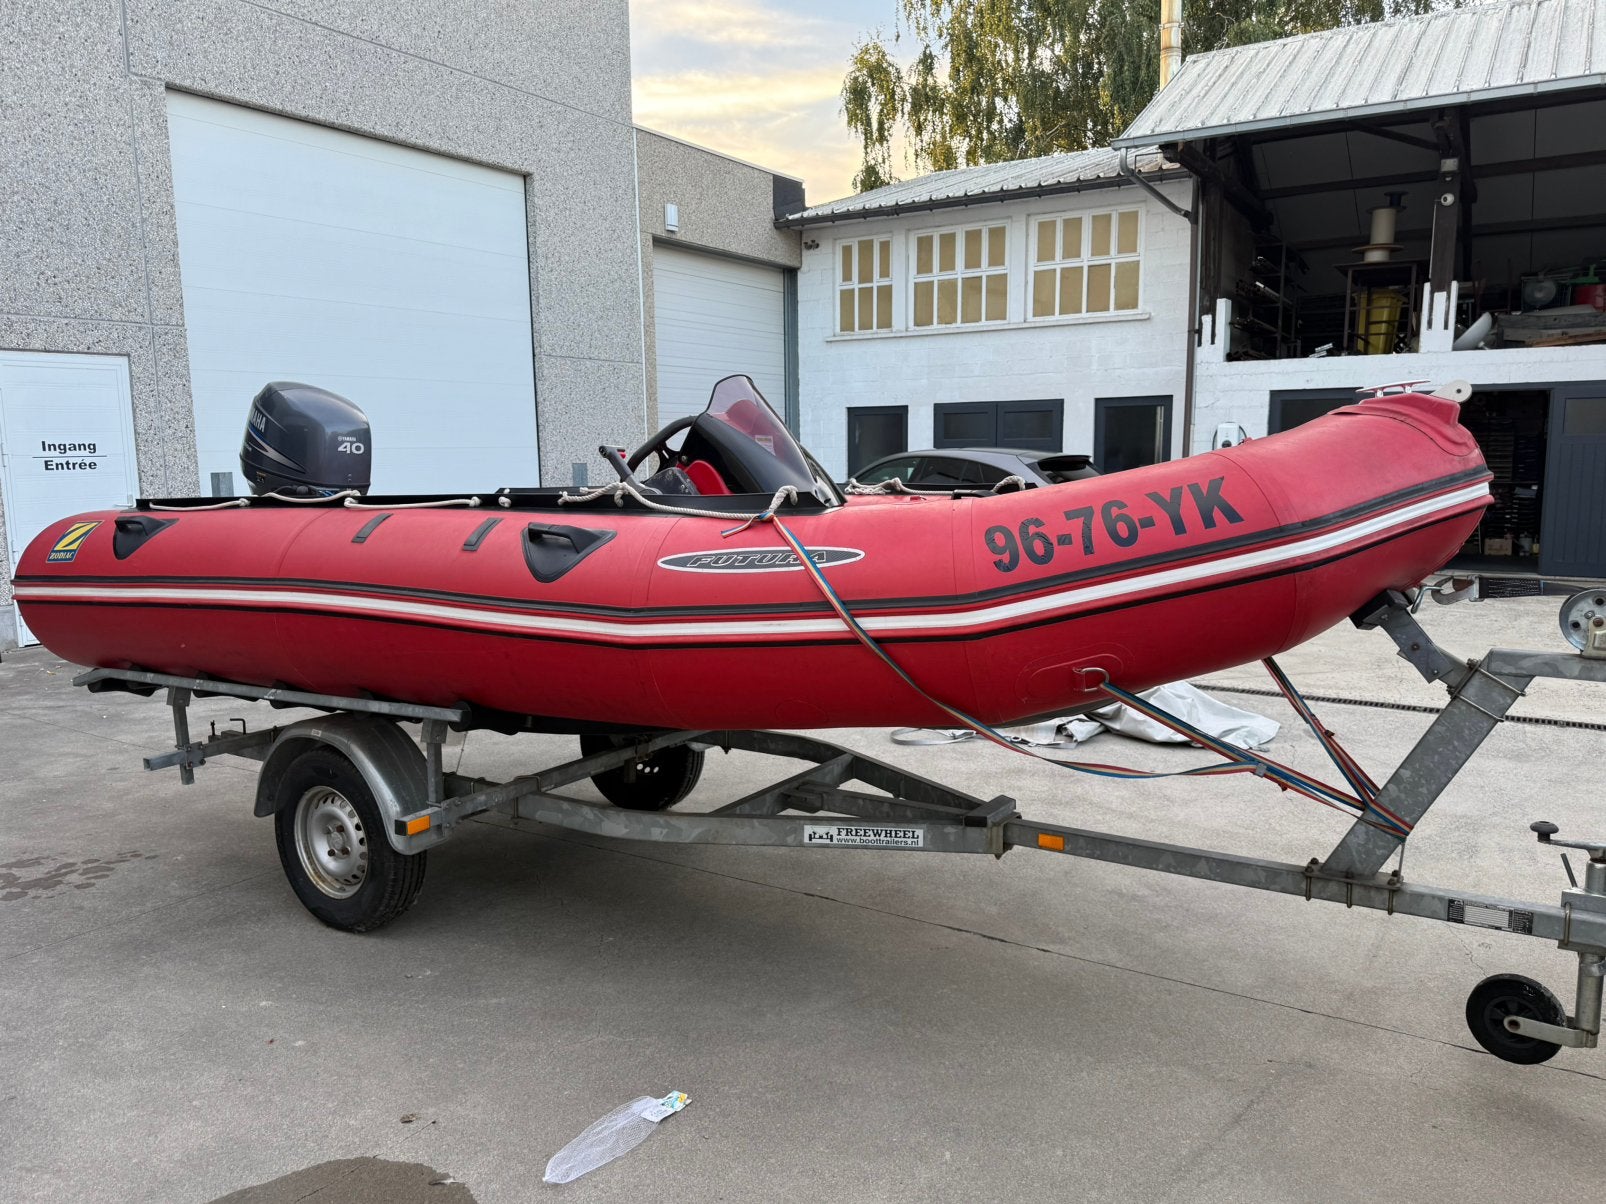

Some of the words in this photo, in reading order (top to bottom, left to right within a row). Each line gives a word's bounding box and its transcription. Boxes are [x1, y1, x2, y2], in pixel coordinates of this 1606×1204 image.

[41, 440, 97, 454] Ingang
[337, 442, 365, 454] 40
[44, 459, 97, 471] Entrée
[984, 476, 1245, 573] 96-76-YK
[49, 551, 75, 560] ZODIAC
[836, 827, 919, 839] FREEWHEEL
[836, 837, 919, 846] www.boottrailers.nl
